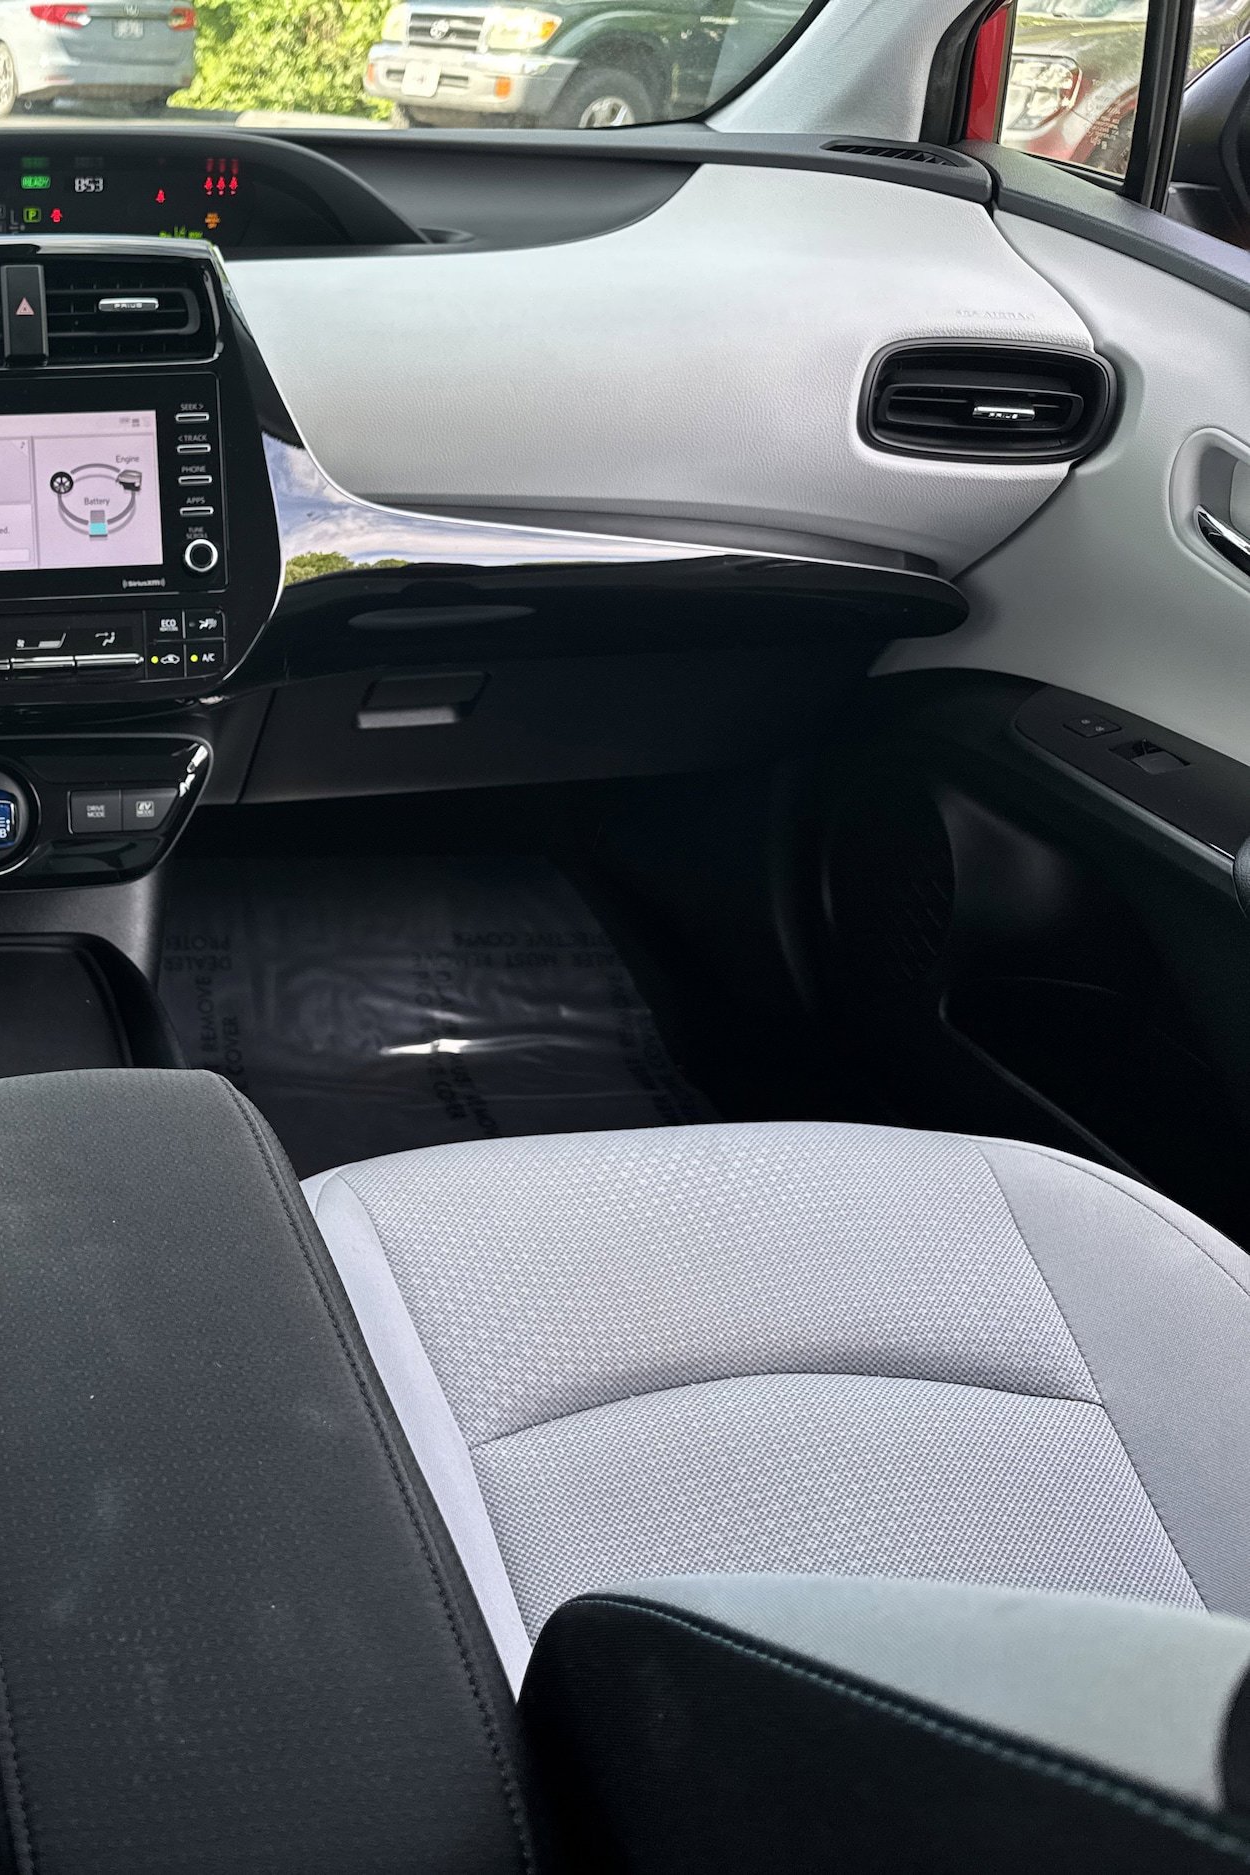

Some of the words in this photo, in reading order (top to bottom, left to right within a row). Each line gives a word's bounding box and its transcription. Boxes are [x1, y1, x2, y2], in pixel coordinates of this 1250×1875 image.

[115, 455, 140, 465] Engine
[181, 465, 207, 473] PHONE
[83, 497, 111, 506] Battery
[160, 619, 177, 627] ECO
[201, 652, 216, 663] A/C
[0, 828, 8, 839] B
